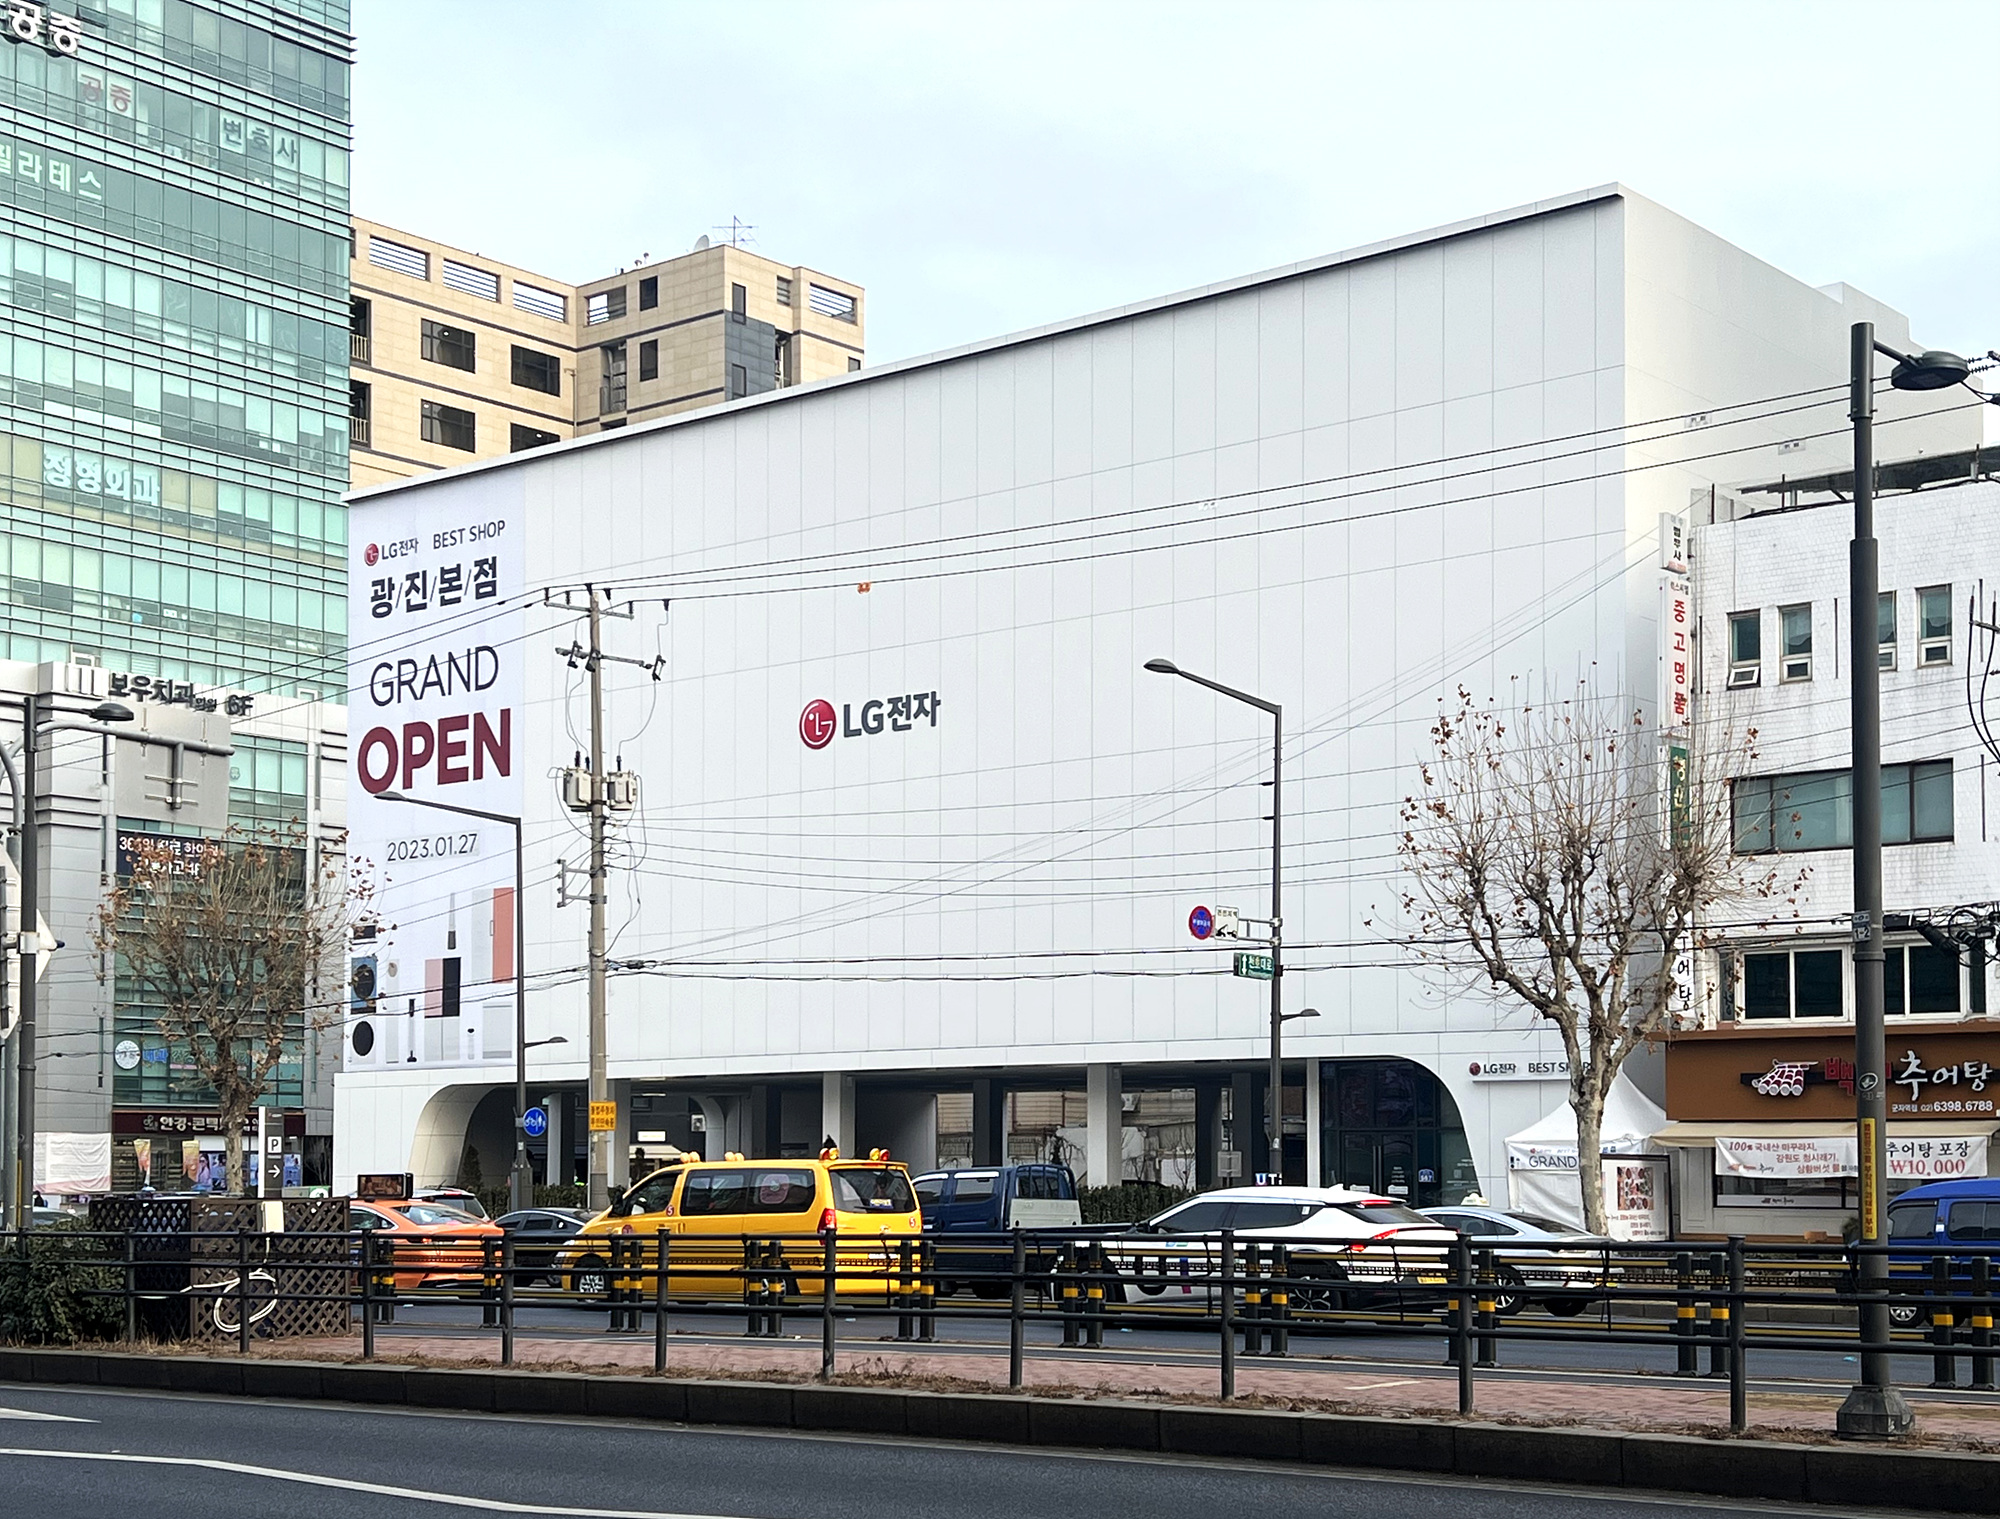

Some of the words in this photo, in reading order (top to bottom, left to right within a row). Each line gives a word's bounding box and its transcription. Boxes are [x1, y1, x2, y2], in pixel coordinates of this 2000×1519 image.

[81, 74, 132, 112] 공증
[223, 116, 298, 164] 변호사
[43, 452, 160, 505] 정형외과
[381, 538, 418, 560] LG전자
[433, 529, 466, 549] BEST
[469, 520, 506, 543] SHOP
[370, 645, 499, 707] GRAND
[843, 690, 942, 738] LG전자
[357, 708, 511, 795] OPEN
[387, 833, 478, 862] 2023.01.27
[1484, 1062, 1517, 1074] LG전자
[1528, 1062, 1557, 1073] BEST
[1895, 1049, 1993, 1102] 추어탕
[271, 1139, 279, 1152] P
[1529, 1155, 1577, 1168] GRAND
[1755, 1142, 1779, 1152] 국내산
[1776, 1153, 1800, 1163] 강원도
[1886, 1142, 1933, 1158] 추어탕
[1938, 1141, 1971, 1157] 포장
